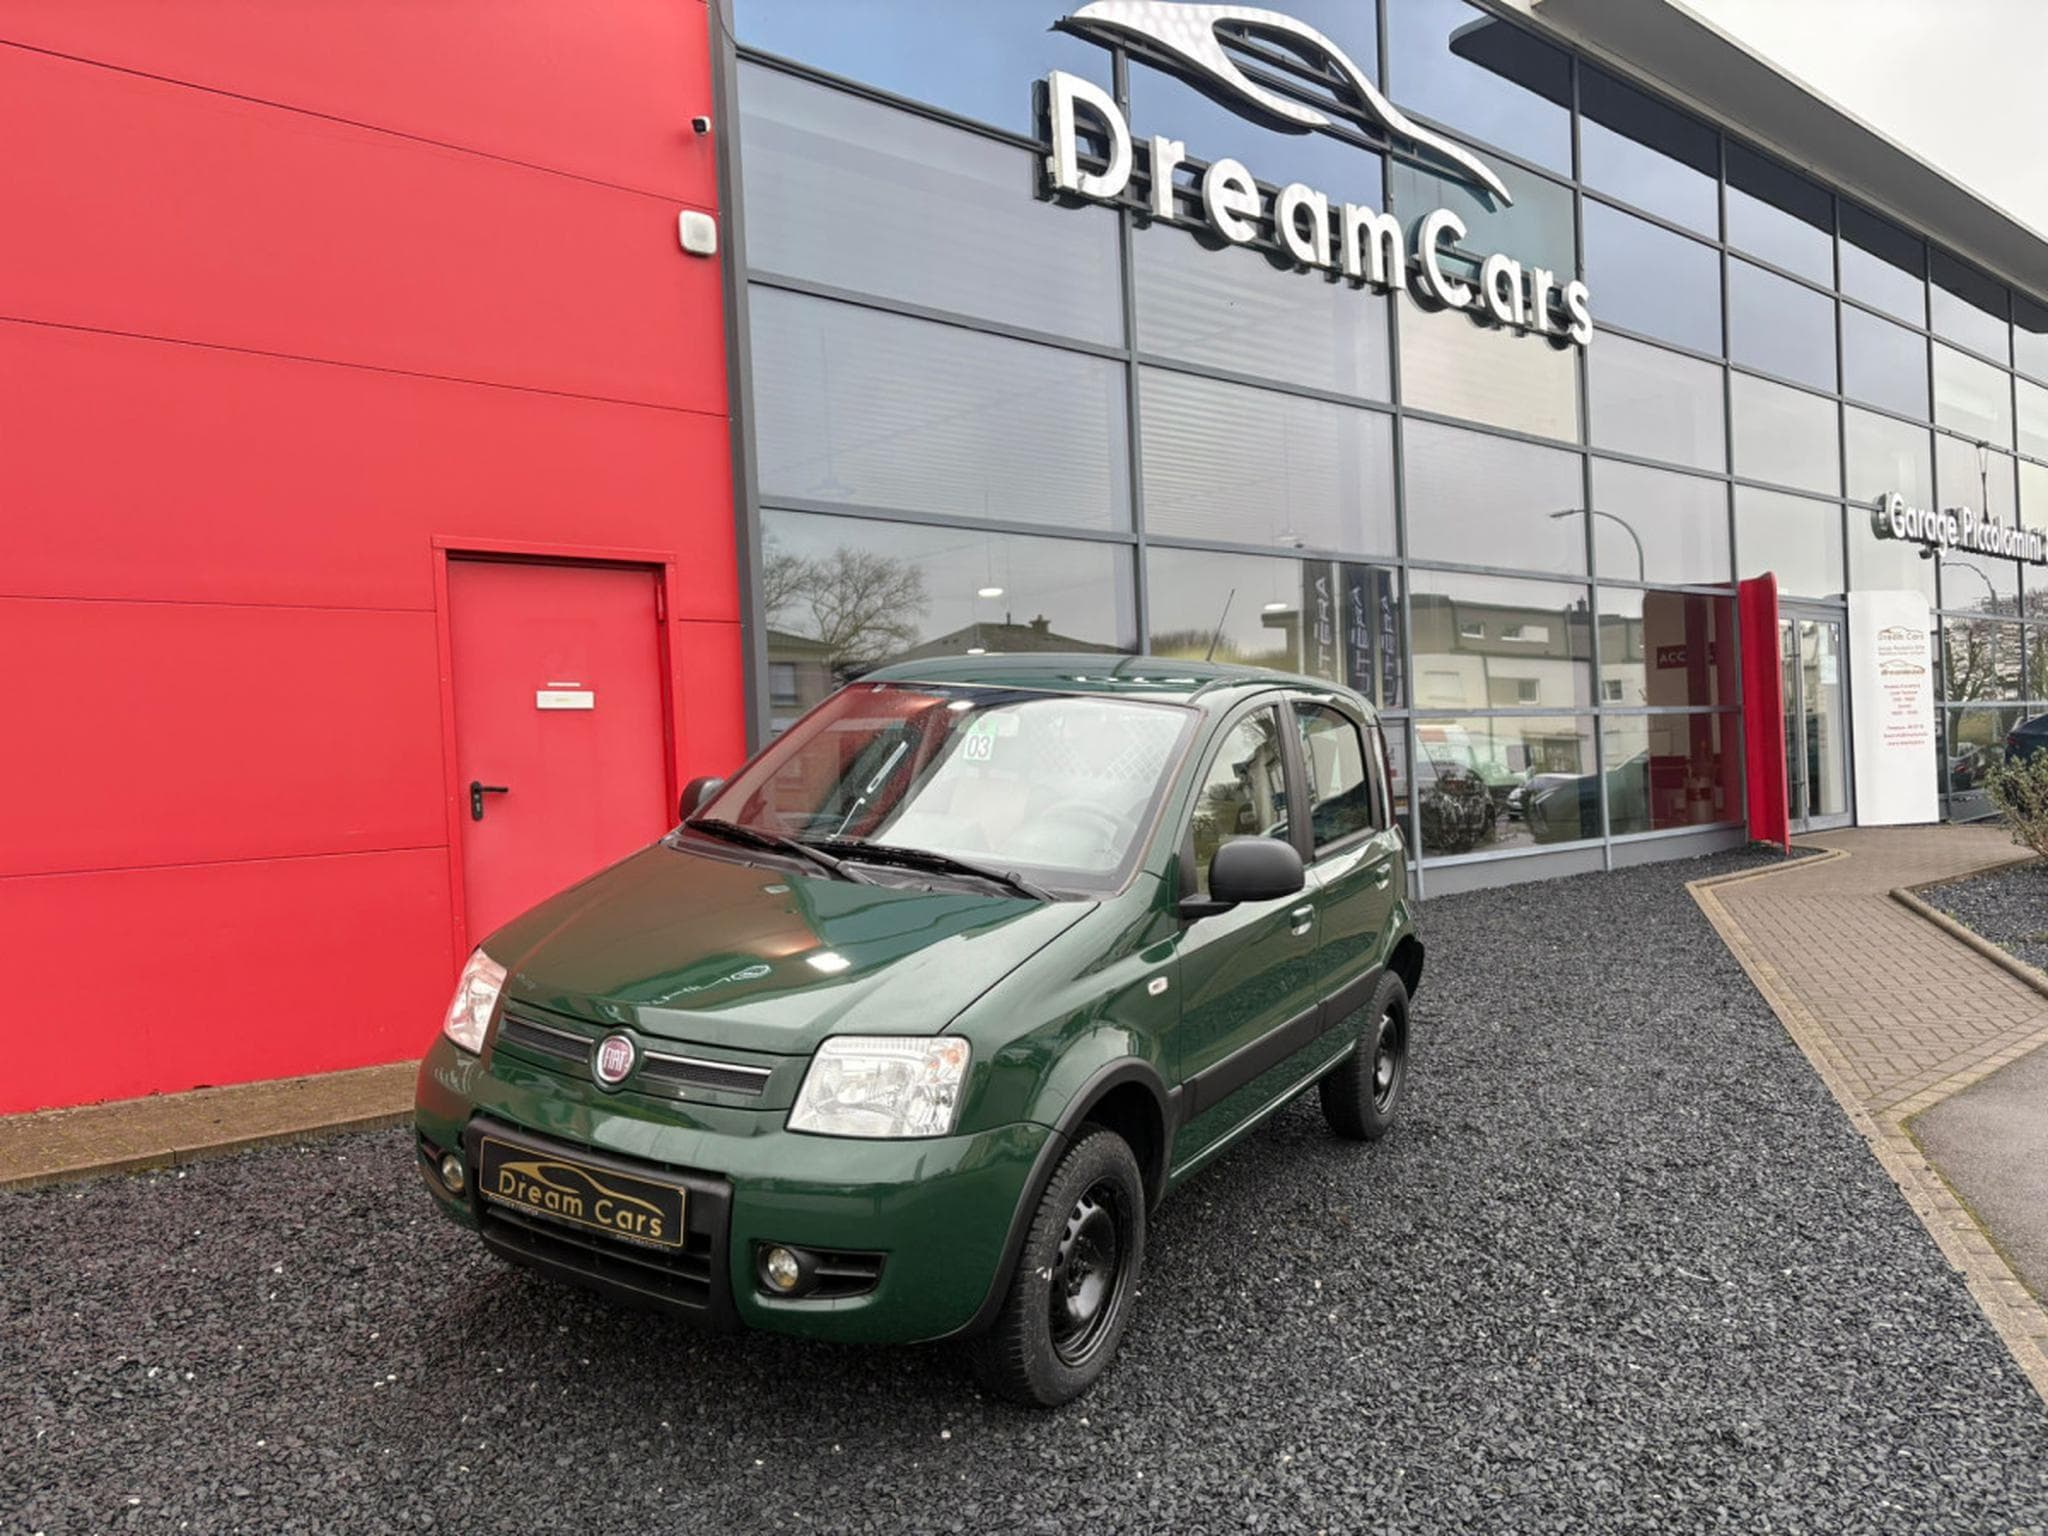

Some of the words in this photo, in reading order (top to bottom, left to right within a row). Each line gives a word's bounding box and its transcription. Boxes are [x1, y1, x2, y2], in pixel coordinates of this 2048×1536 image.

[1045, 70, 1406, 290] Dream
[1416, 207, 1593, 345] Cars
[1891, 492, 1959, 557] Garage
[1963, 507, 2041, 561] Piccolomini
[967, 735, 991, 758] 03
[603, 1047, 628, 1072] FIAT
[498, 1169, 584, 1217] Dream
[594, 1199, 664, 1238] Cars
